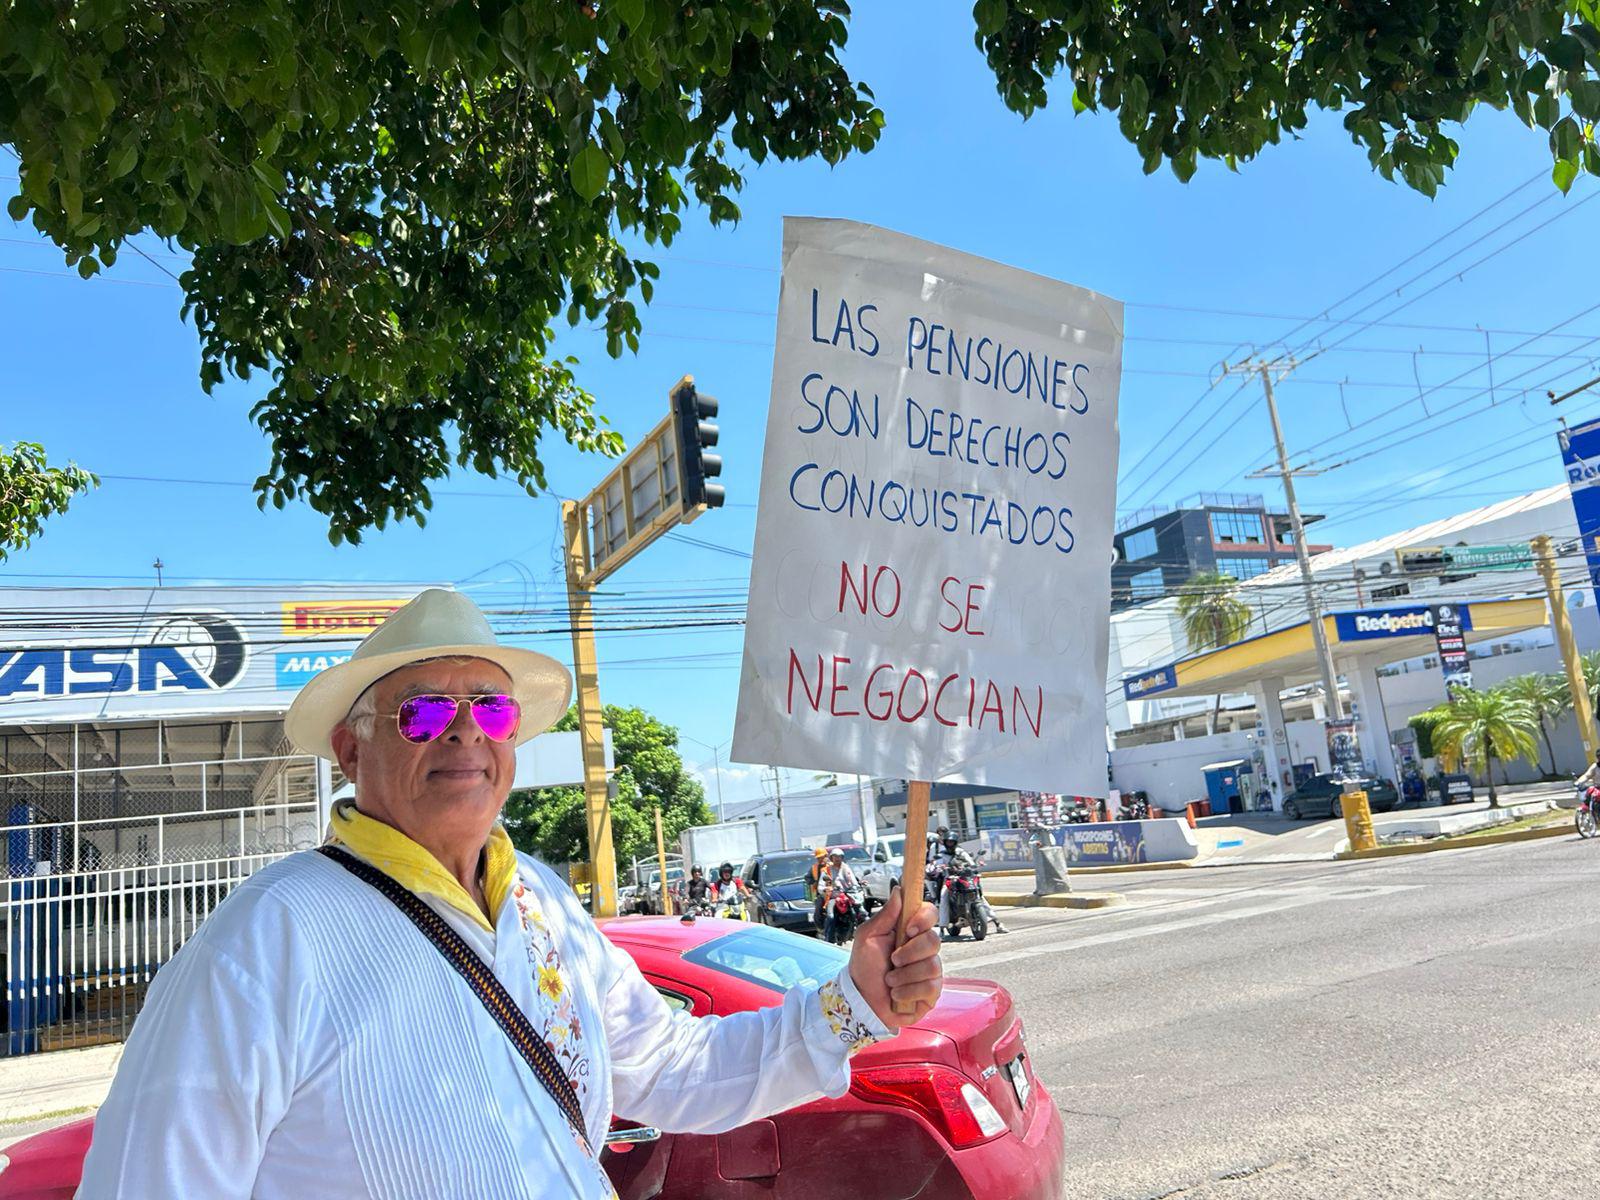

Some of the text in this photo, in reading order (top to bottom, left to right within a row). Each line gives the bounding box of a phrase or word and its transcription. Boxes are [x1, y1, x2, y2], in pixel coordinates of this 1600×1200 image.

[811, 287, 1091, 416] LAS PENSIONES
[797, 373, 1071, 480] SON DERECHOS
[789, 463, 1076, 554] CONQUISTADOS
[838, 560, 986, 636] NO SE
[282, 655, 351, 673] MAX
[787, 647, 1043, 739] NEGOCIAN
